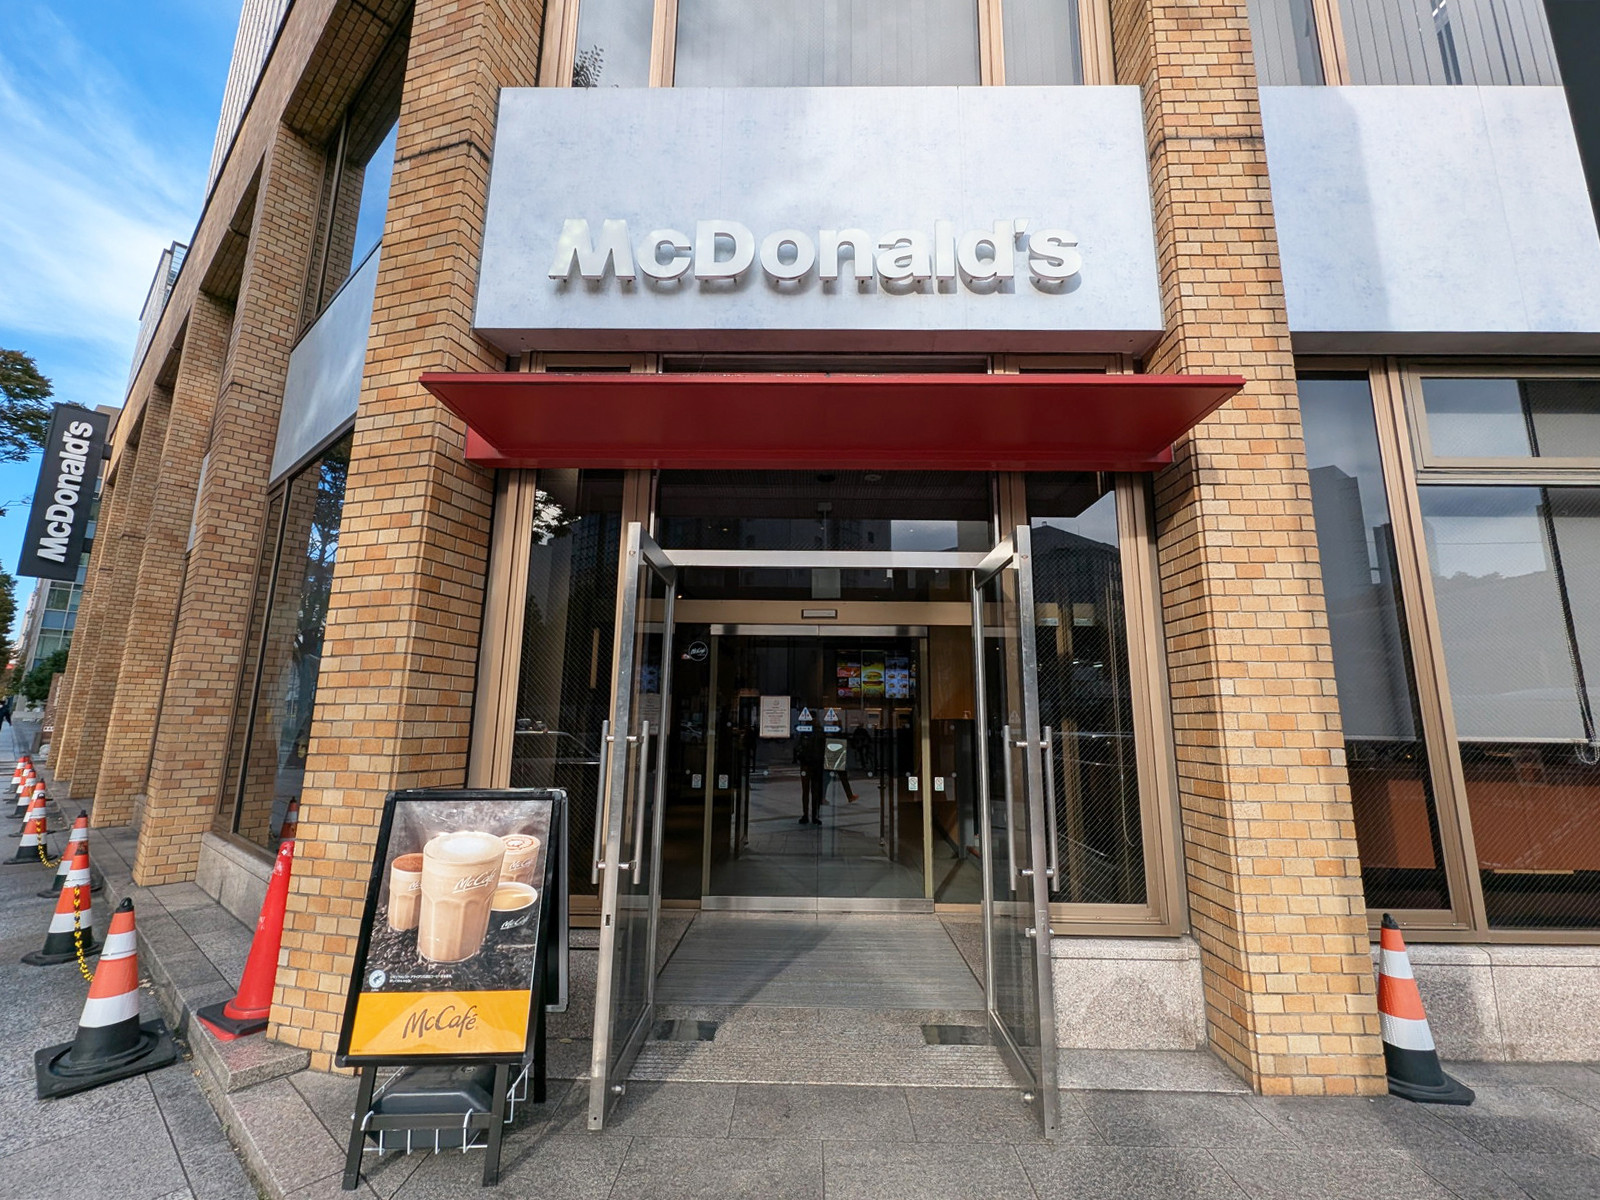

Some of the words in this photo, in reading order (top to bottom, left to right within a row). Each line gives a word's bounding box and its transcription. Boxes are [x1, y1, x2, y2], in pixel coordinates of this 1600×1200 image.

[548, 218, 1082, 281] McDonald's
[36, 420, 94, 563] McDonald's
[402, 1005, 478, 1039] McCafé
